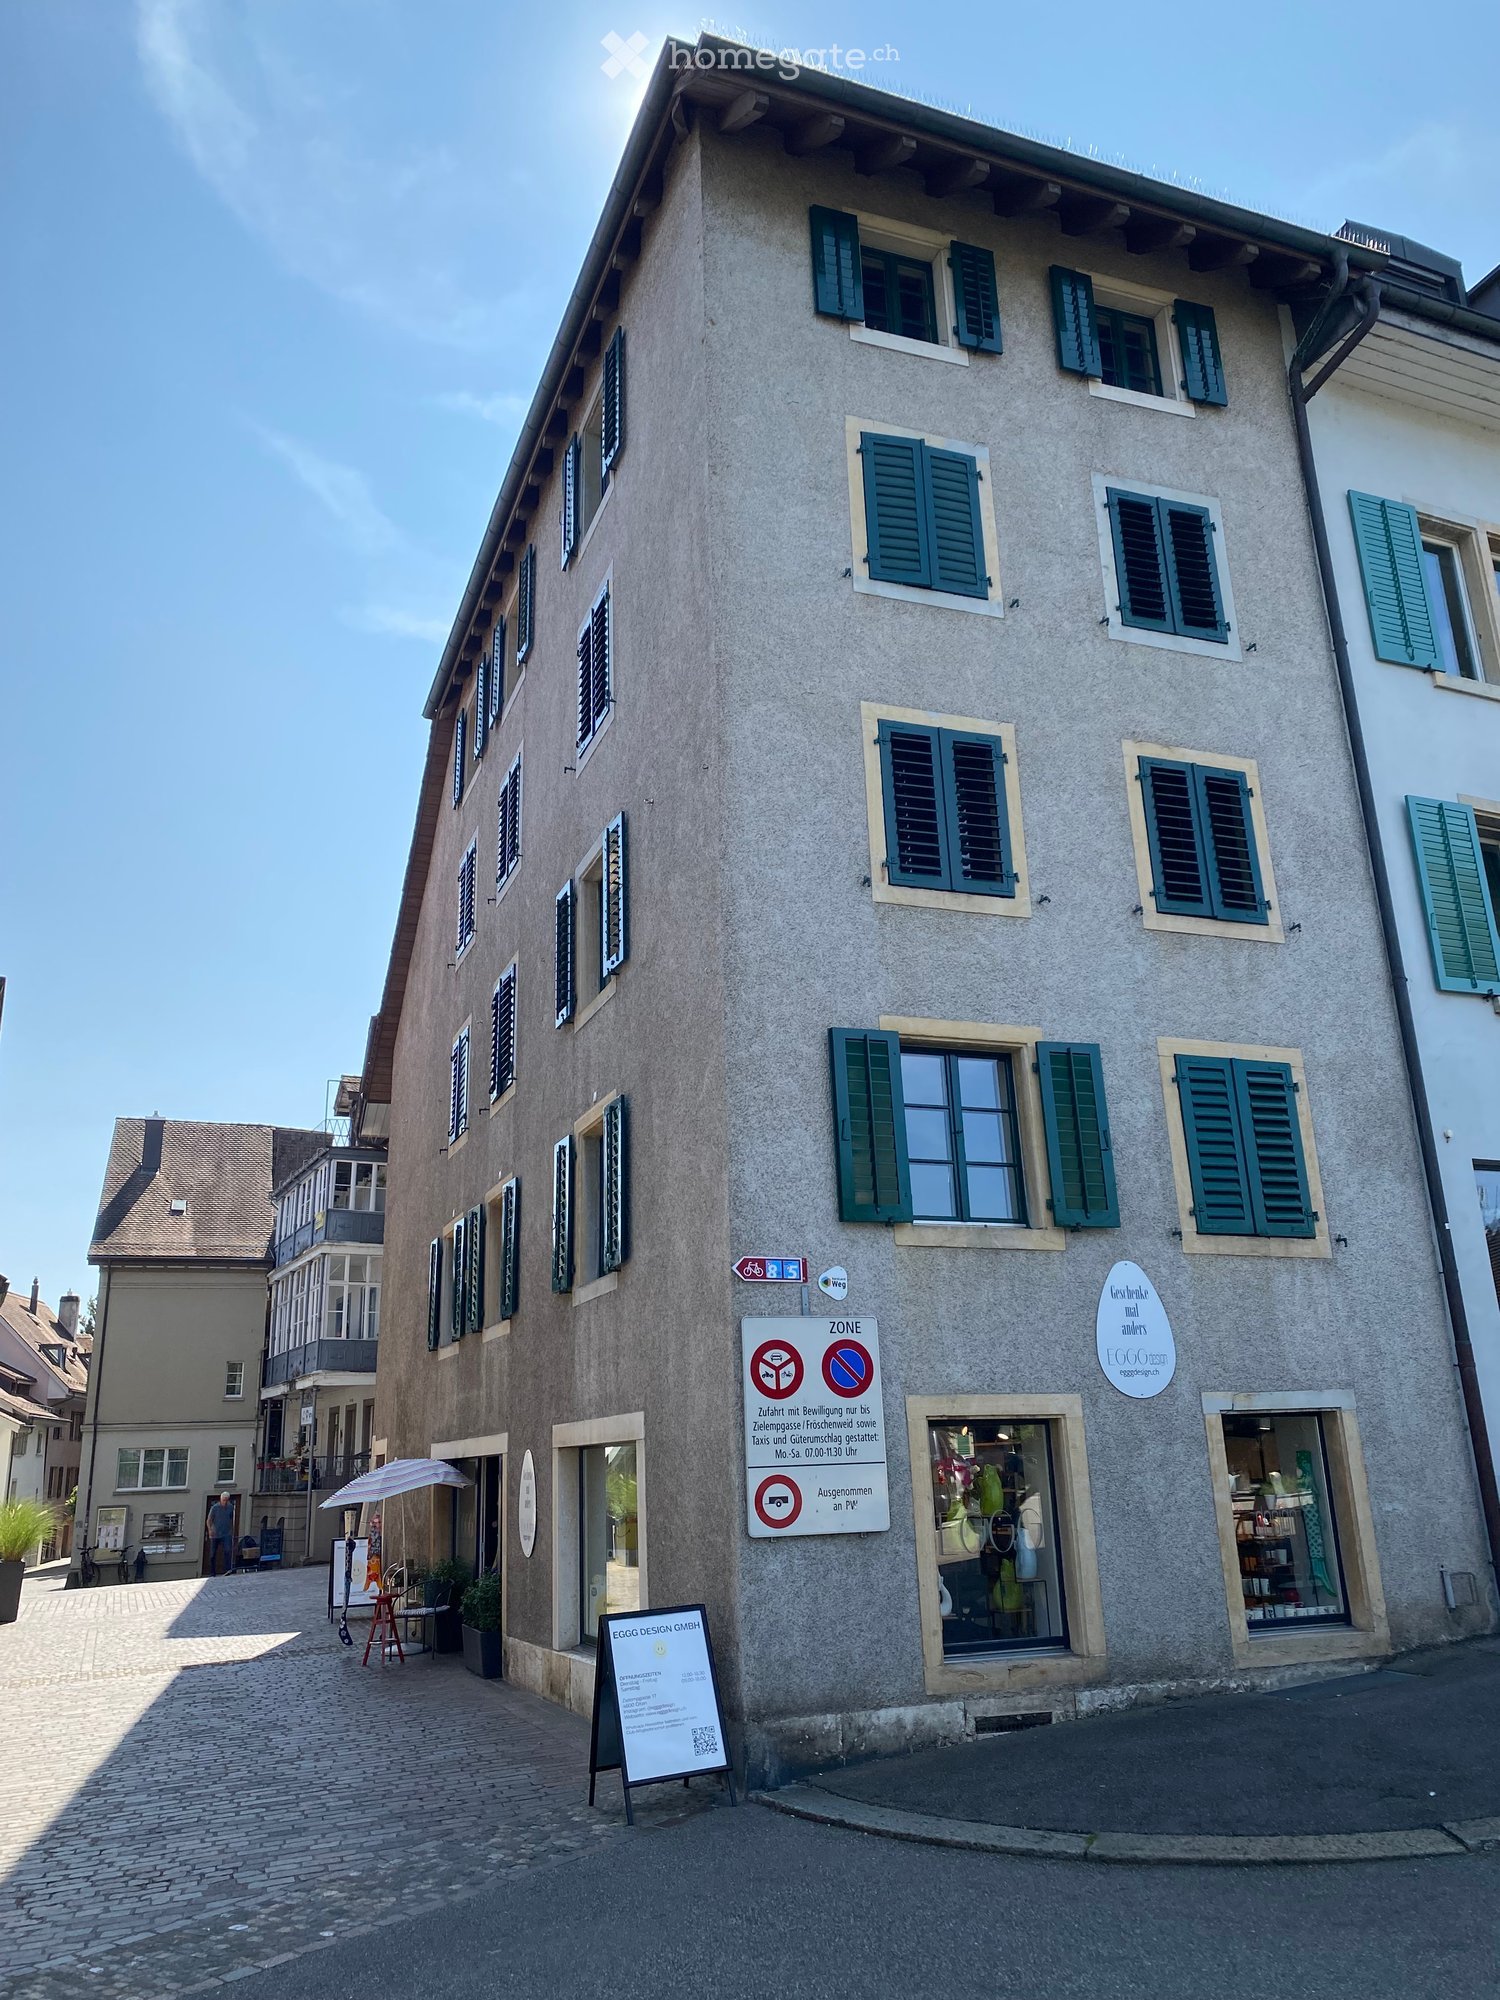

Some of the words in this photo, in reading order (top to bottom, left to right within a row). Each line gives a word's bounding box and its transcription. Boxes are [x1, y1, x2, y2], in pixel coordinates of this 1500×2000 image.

[767, 1264, 777, 1278] 8
[787, 1265, 798, 1279] 5
[832, 1281, 846, 1289] Weg
[1110, 1285, 1149, 1299] Geschenke
[1124, 1303, 1139, 1318] mal
[829, 1321, 862, 1334] ZONE
[1121, 1321, 1148, 1336] anders
[1106, 1347, 1149, 1366] EGGG
[1119, 1367, 1160, 1378] egggdesign.ch
[758, 1407, 785, 1417] Zufahrt
[788, 1406, 799, 1416] mit
[803, 1405, 843, 1417] Bewilligung
[846, 1407, 857, 1415] nur
[860, 1404, 871, 1415] bis
[856, 1419, 877, 1429] sowie
[752, 1434, 770, 1445] Taxis
[773, 1435, 787, 1444] und
[790, 1433, 842, 1445] Güterumschlag
[845, 1433, 879, 1444] gestattet:
[775, 1448, 802, 1459] Mo.-Sa.
[804, 1447, 842, 1458] 07.00-11.30
[845, 1446, 858, 1456] Uhr
[817, 1487, 873, 1499] Ausgenommen
[833, 1503, 843, 1511] an
[612, 1629, 639, 1640] EGGG
[640, 1625, 673, 1636] DESIGN
[673, 1621, 701, 1632] GMBH
